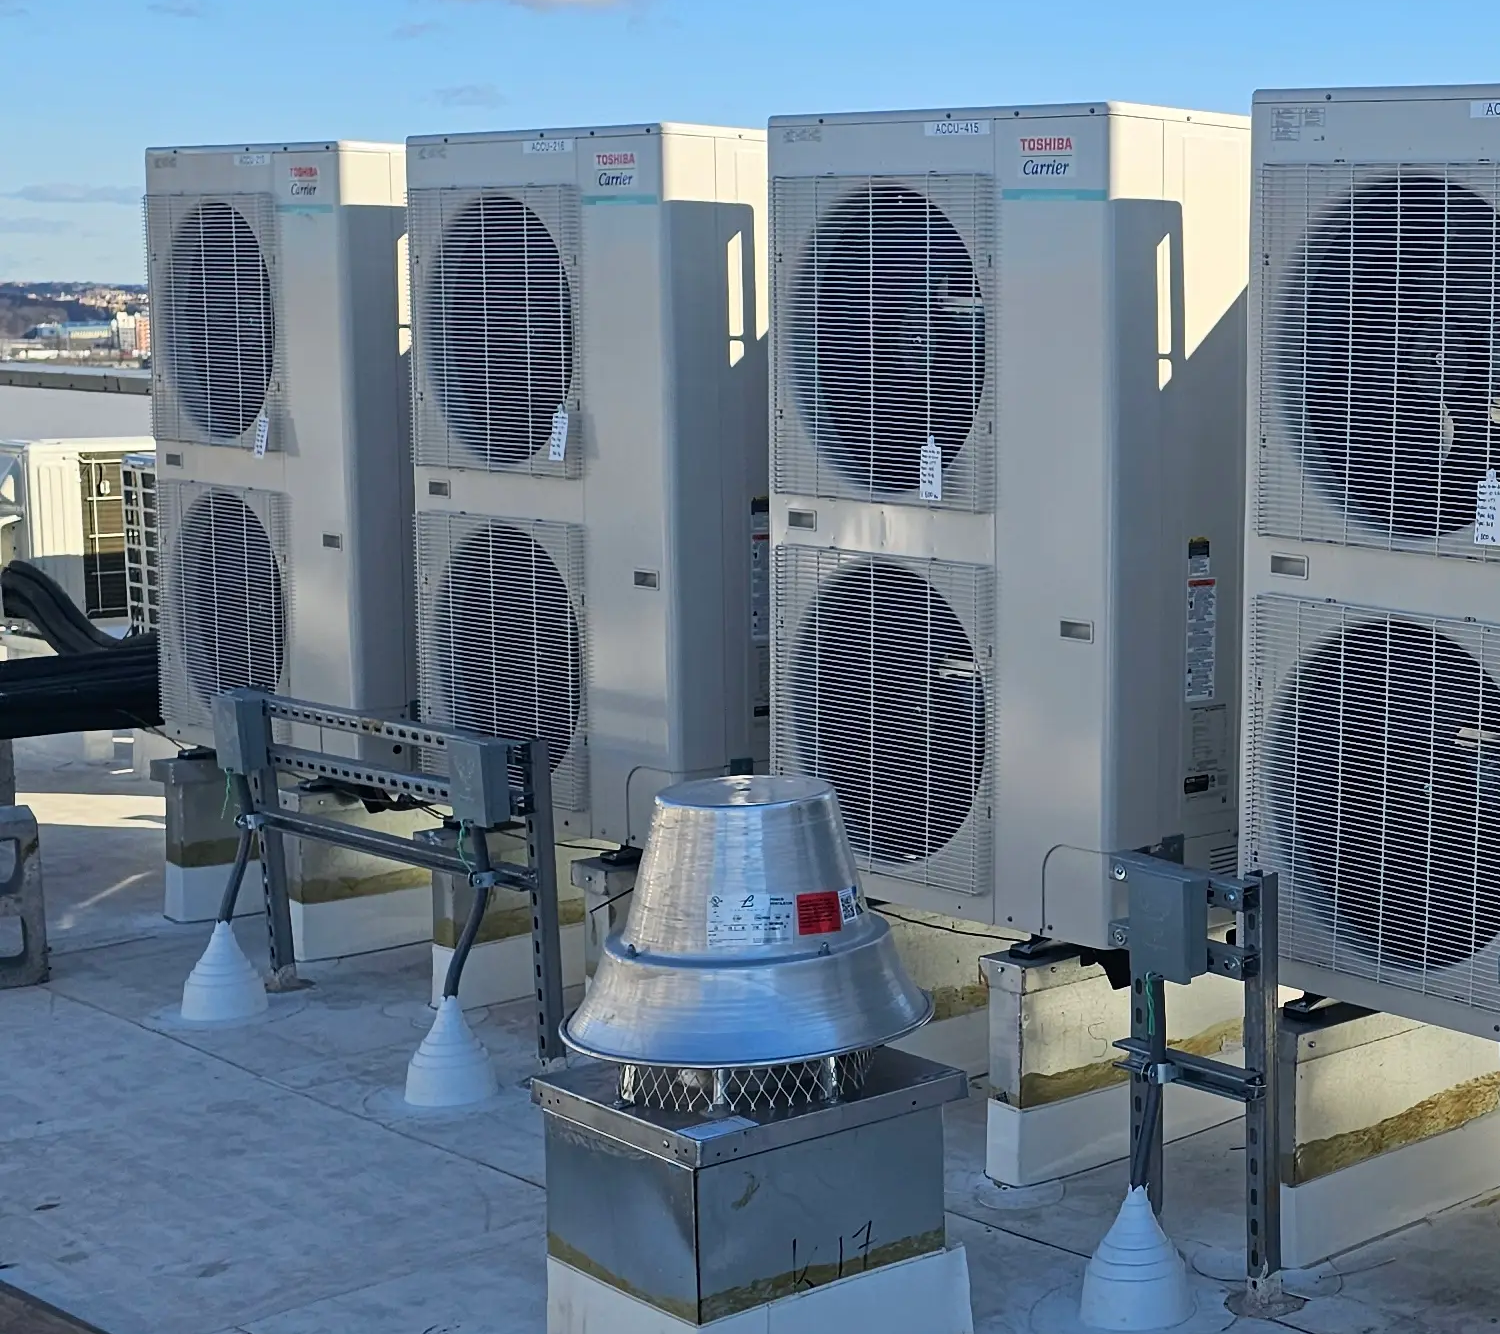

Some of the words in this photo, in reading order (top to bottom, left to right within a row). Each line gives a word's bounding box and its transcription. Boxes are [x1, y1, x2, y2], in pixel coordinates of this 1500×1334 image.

[935, 123, 979, 134] ACCU-415
[1019, 137, 1073, 151] TOSHIBA
[595, 153, 635, 165] TOSHIBA
[289, 166, 318, 178] TOSHIBA
[1022, 159, 1070, 176] Carrier
[598, 172, 633, 187] Carrier
[290, 182, 317, 196] Carrier
